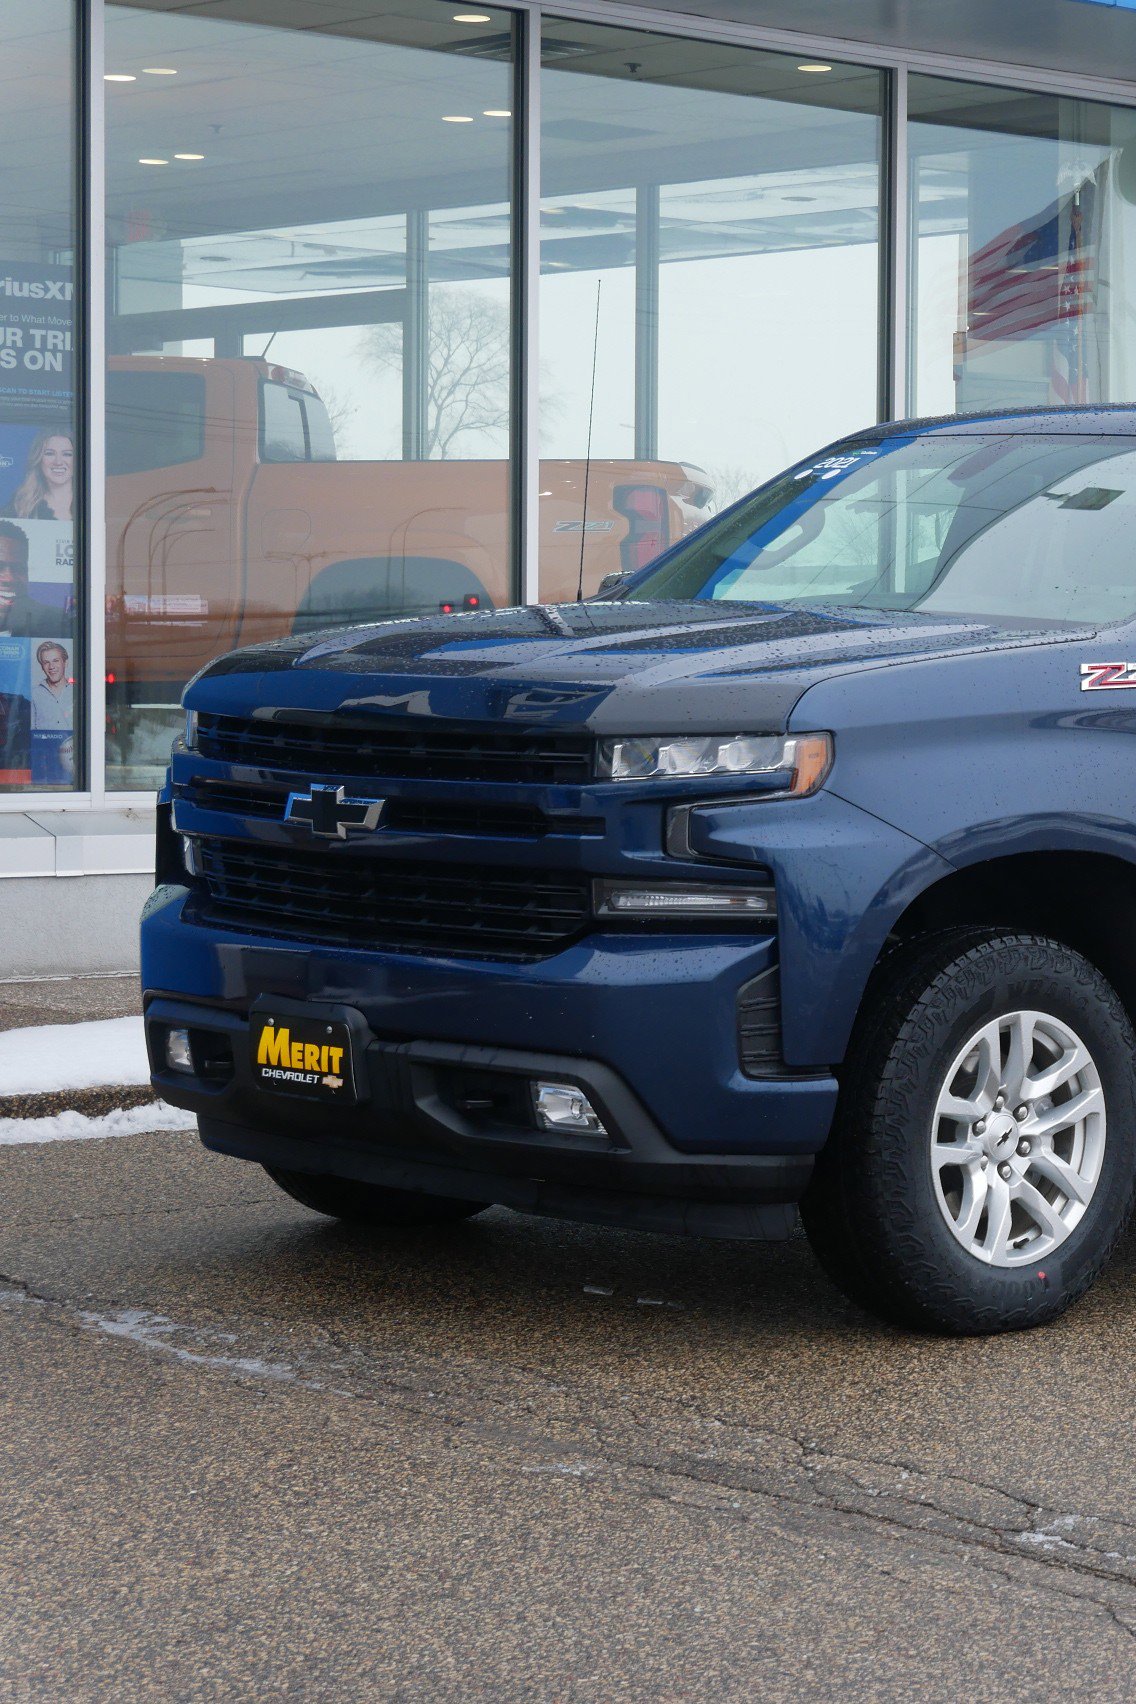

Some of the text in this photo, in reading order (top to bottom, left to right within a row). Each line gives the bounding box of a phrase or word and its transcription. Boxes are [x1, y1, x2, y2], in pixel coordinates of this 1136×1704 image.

[21, 314, 45, 324] What
[30, 329, 73, 350] TRI
[24, 350, 62, 371] ON
[262, 1068, 320, 1084] CHEVROLET
